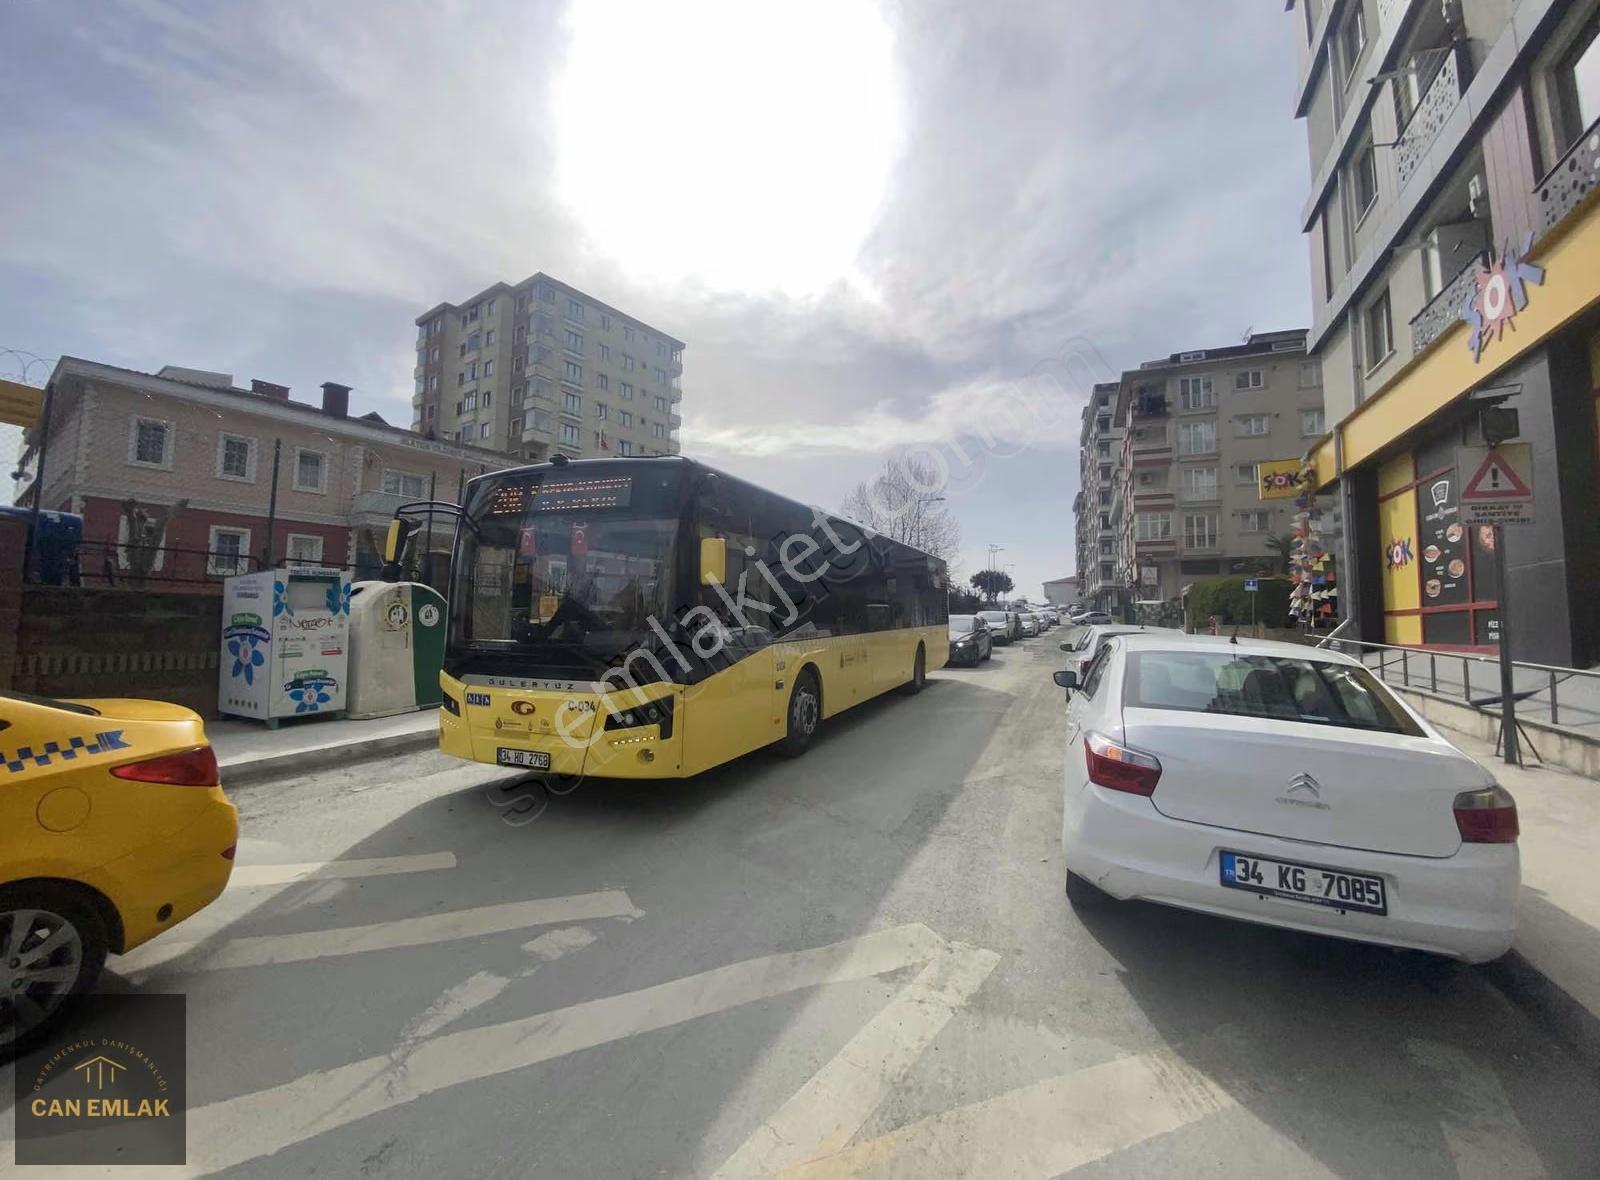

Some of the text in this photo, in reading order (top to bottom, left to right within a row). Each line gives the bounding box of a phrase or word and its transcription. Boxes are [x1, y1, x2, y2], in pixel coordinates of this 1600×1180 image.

[502, 750, 511, 761] 34
[529, 754, 548, 766] 2768
[1236, 858, 1264, 885] 34
[1277, 865, 1306, 892] KG
[1322, 873, 1380, 905] 7085
